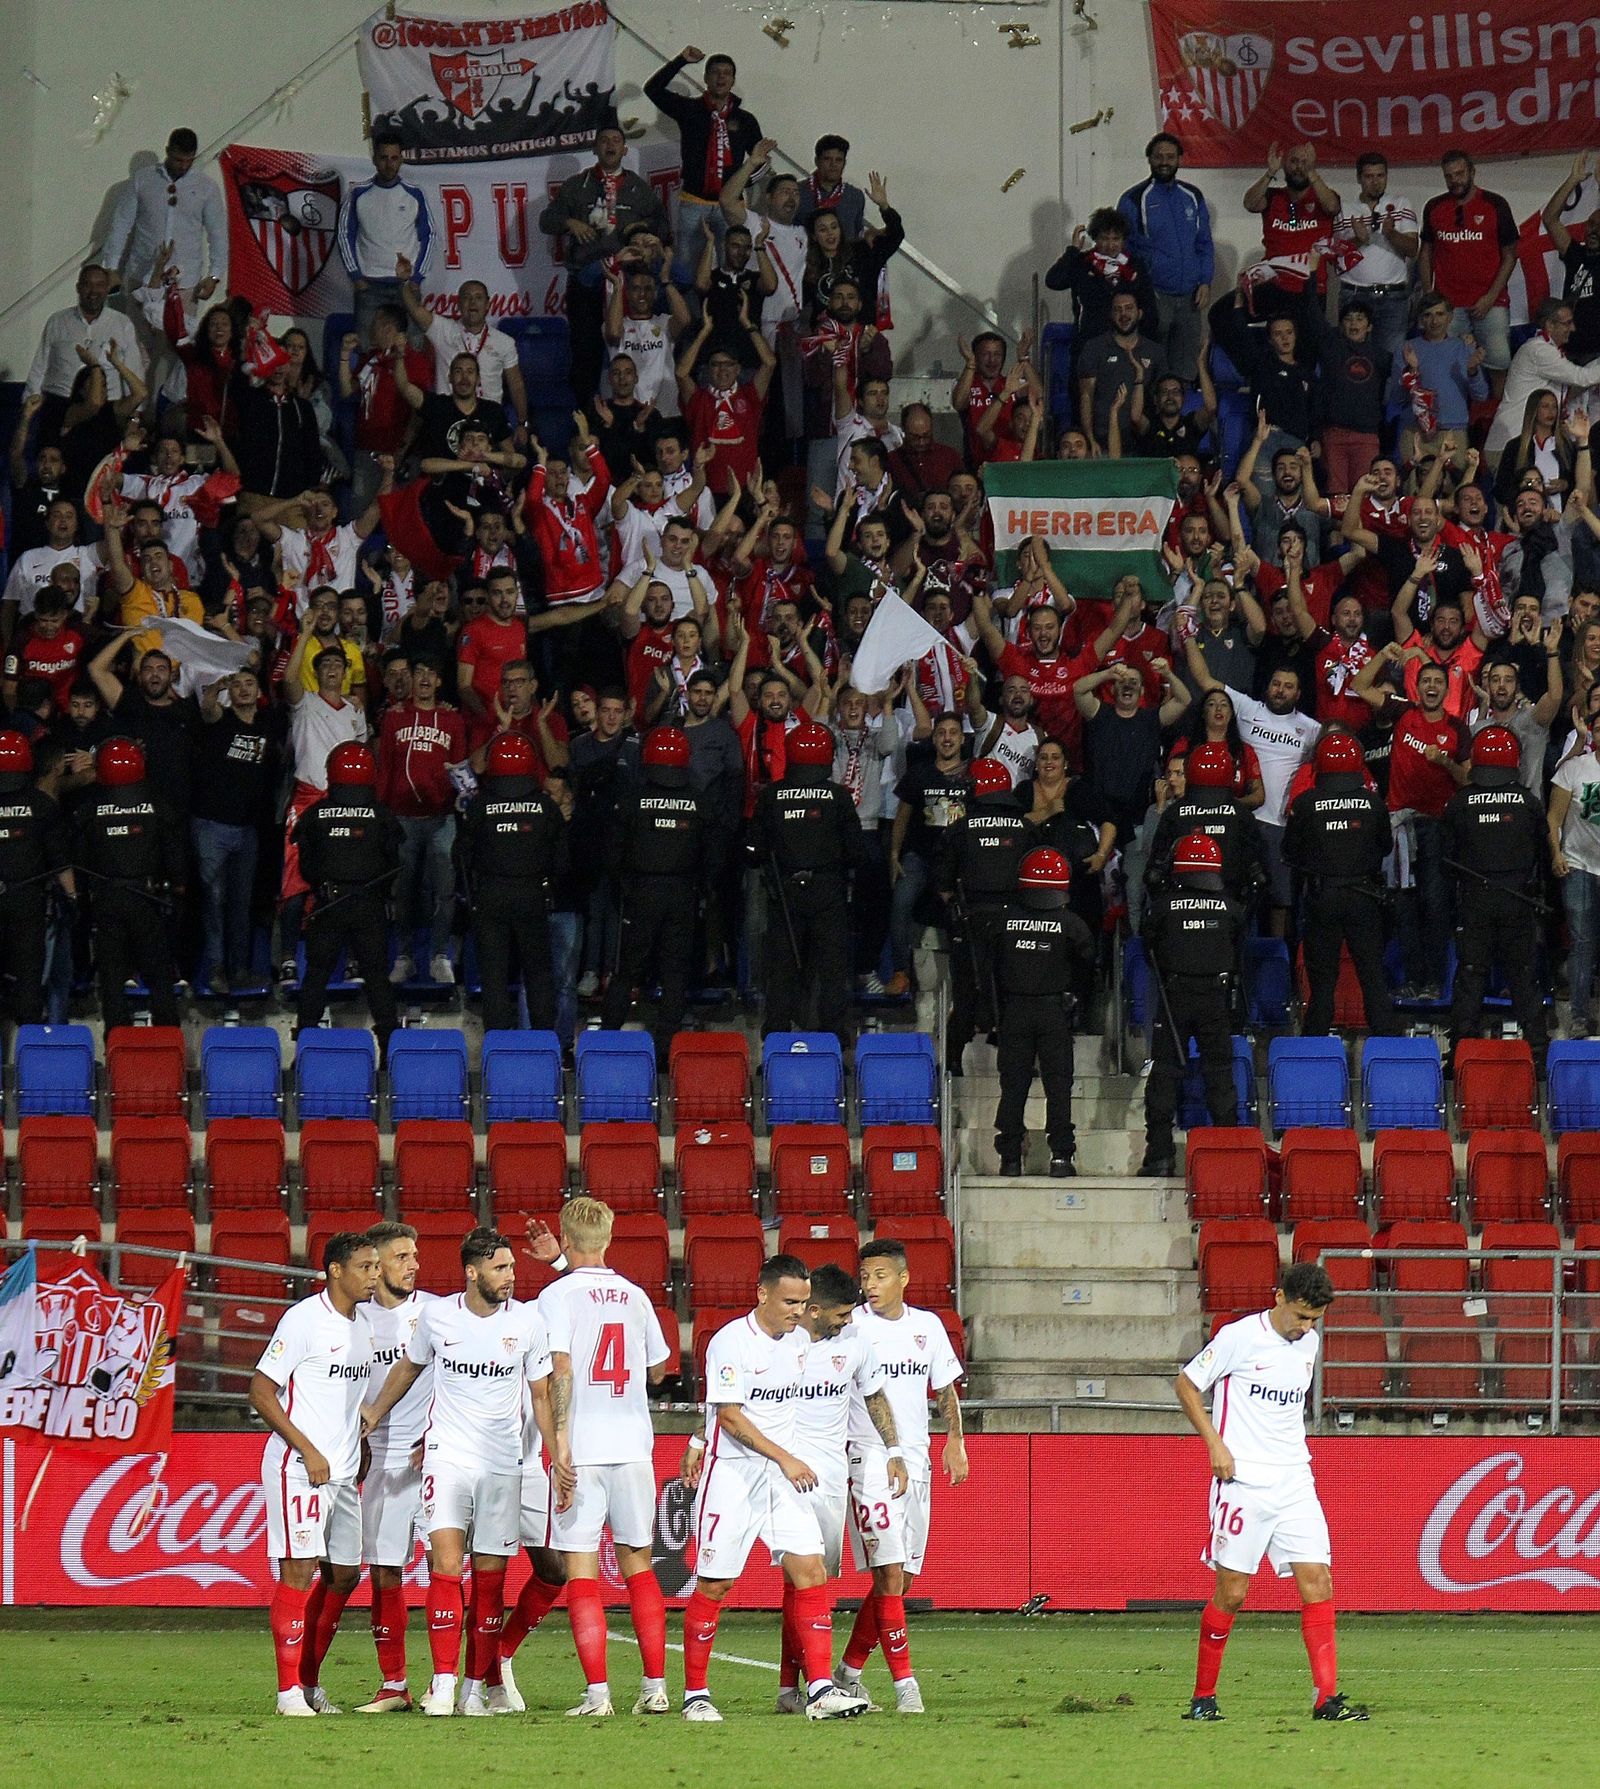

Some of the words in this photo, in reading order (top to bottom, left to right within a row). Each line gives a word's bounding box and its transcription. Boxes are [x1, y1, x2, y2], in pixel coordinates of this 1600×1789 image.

[421, 145, 488, 160] ESTAMOS
[492, 137, 557, 154] CONTIGO
[1438, 230, 1483, 242] Playtika
[624, 340, 664, 353] Playtika
[1007, 509, 1159, 536] HERRERA
[1250, 725, 1302, 749] Playtika
[412, 741, 432, 753] 1991
[1403, 732, 1448, 757] Playa
[777, 788, 833, 801] ERTZAINTZA
[924, 788, 946, 796] TRUE
[1468, 792, 1525, 805] ERTZAINTZA
[486, 802, 543, 815] ERTZAINTZA
[640, 798, 697, 812] ERTZAINTZA
[1315, 798, 1371, 811] ERTZAINTZA
[318, 807, 375, 819] ERTZAINTZA
[497, 823, 518, 833] C7F4
[968, 817, 1024, 829] ERTZAINTZA
[979, 838, 999, 847] Y2A9
[1170, 898, 1227, 911] ERTZAINTZA
[1006, 919, 1062, 934] ERTZAINTZA
[1183, 920, 1205, 930] L9B1
[1015, 939, 1036, 950] A2C5
[1066, 1195, 1074, 1206] 3
[588, 1287, 629, 1305] KJÆR
[1072, 1288, 1081, 1300] 2
[588, 1321, 631, 1397] 4
[442, 1361, 514, 1378] Playtika
[1086, 1383, 1094, 1394] 1
[94, 1397, 139, 1440] GO
[424, 1475, 435, 1501] 3
[291, 1493, 320, 1524] 14
[858, 1502, 890, 1533] 23
[1219, 1501, 1244, 1535] 16
[707, 1513, 720, 1542] 7
[434, 1610, 454, 1619] SFC
[889, 1627, 906, 1641] SFC
